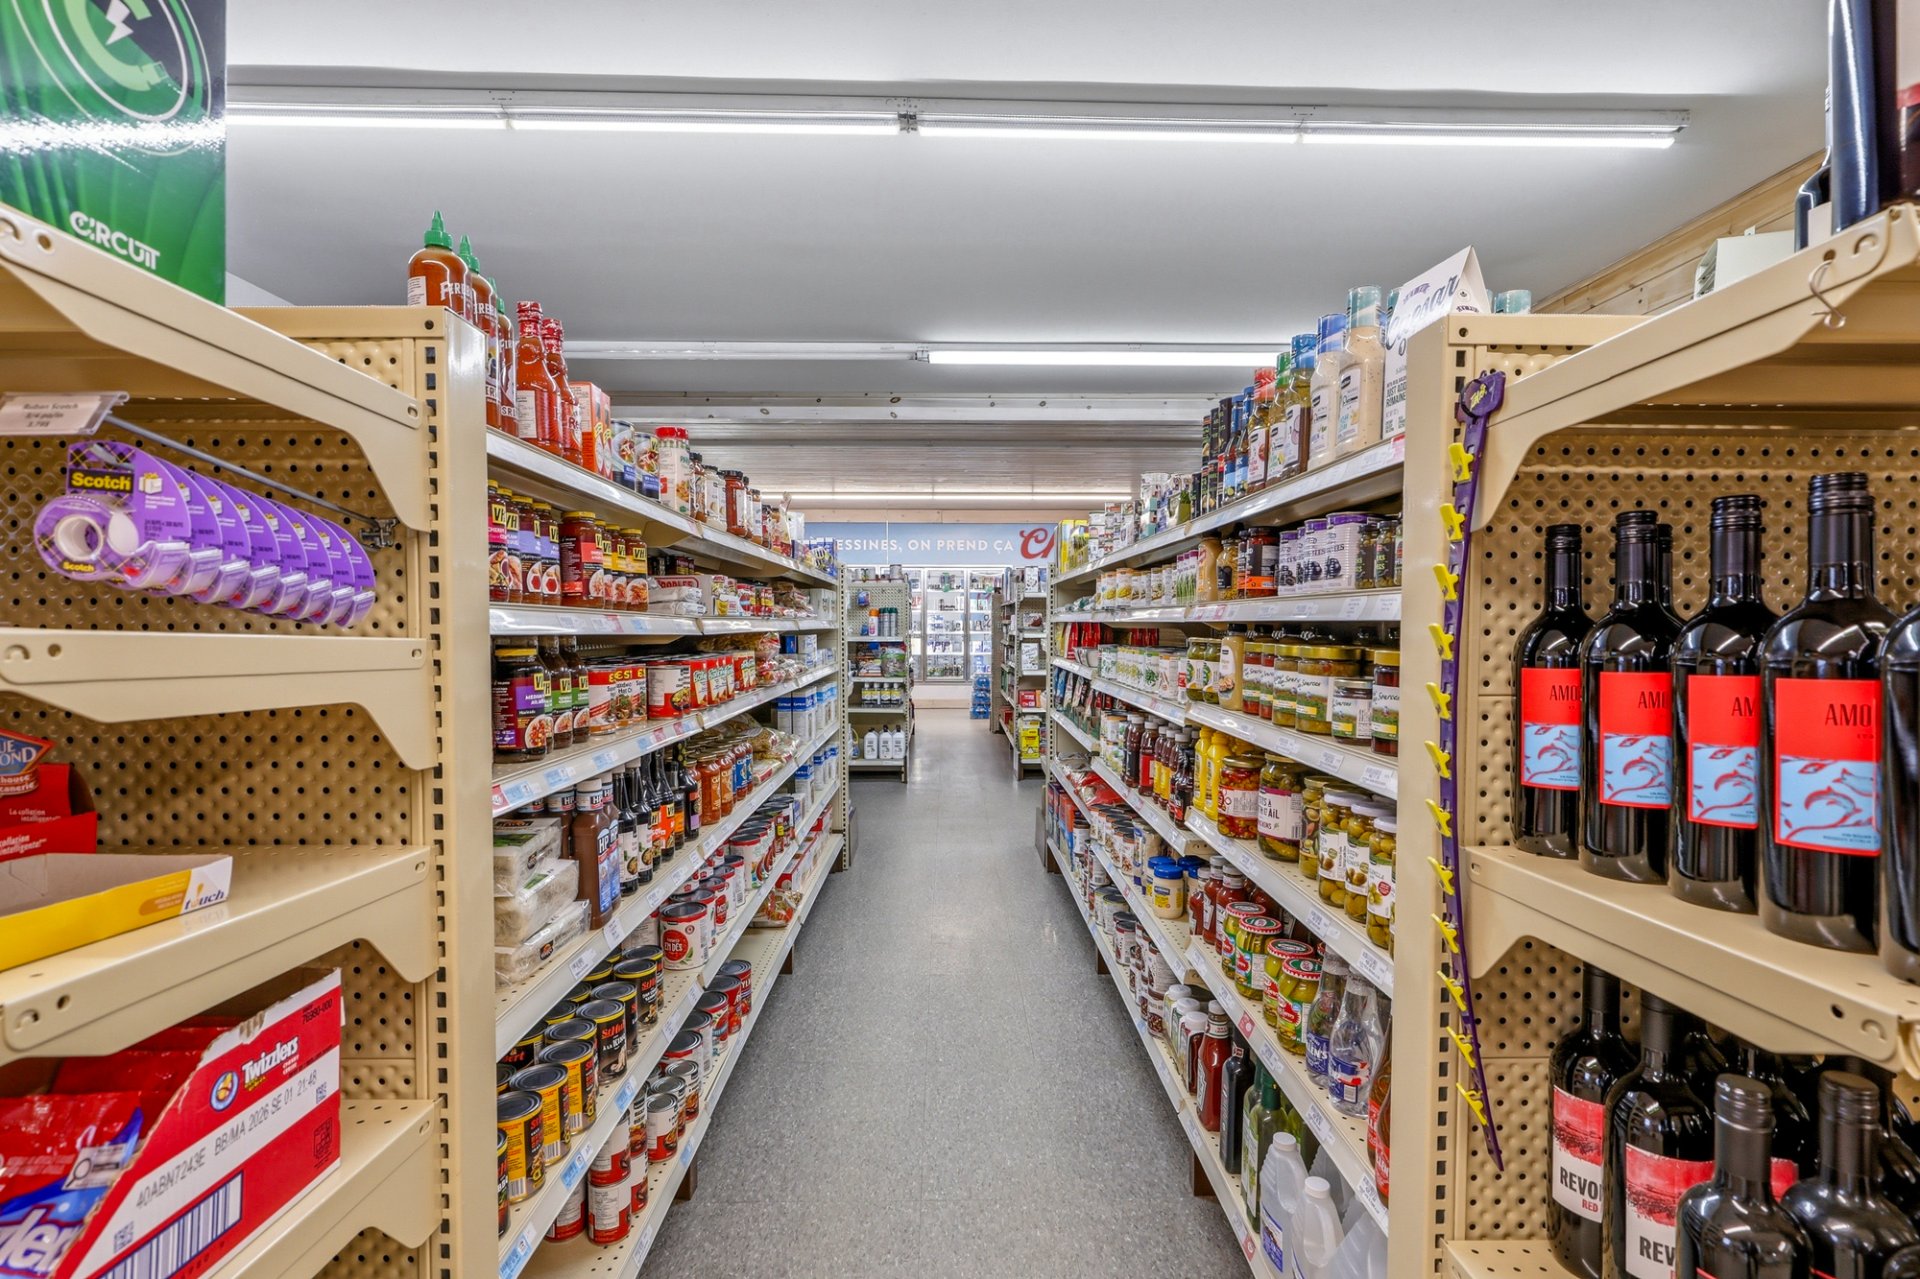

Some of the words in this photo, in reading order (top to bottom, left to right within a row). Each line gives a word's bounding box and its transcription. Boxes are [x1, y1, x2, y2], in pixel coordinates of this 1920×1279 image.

[69, 210, 161, 271] CIRCUIT
[71, 471, 132, 491] Scotch
[634, 548, 647, 560] VH
[907, 539, 932, 551] ON
[936, 539, 989, 551] PREND
[993, 539, 1014, 555] ÇA
[63, 561, 95, 574] Scotch
[1824, 703, 1873, 728] AMO
[609, 828, 619, 843] HP
[598, 837, 610, 853] HP
[241, 1035, 300, 1084] Twizzlers
[248, 1103, 270, 1132] 2026
[271, 1092, 283, 1115] SE
[283, 1087, 293, 1106] 01
[1559, 1166, 1600, 1200] REVO
[1581, 1198, 1599, 1213] RED
